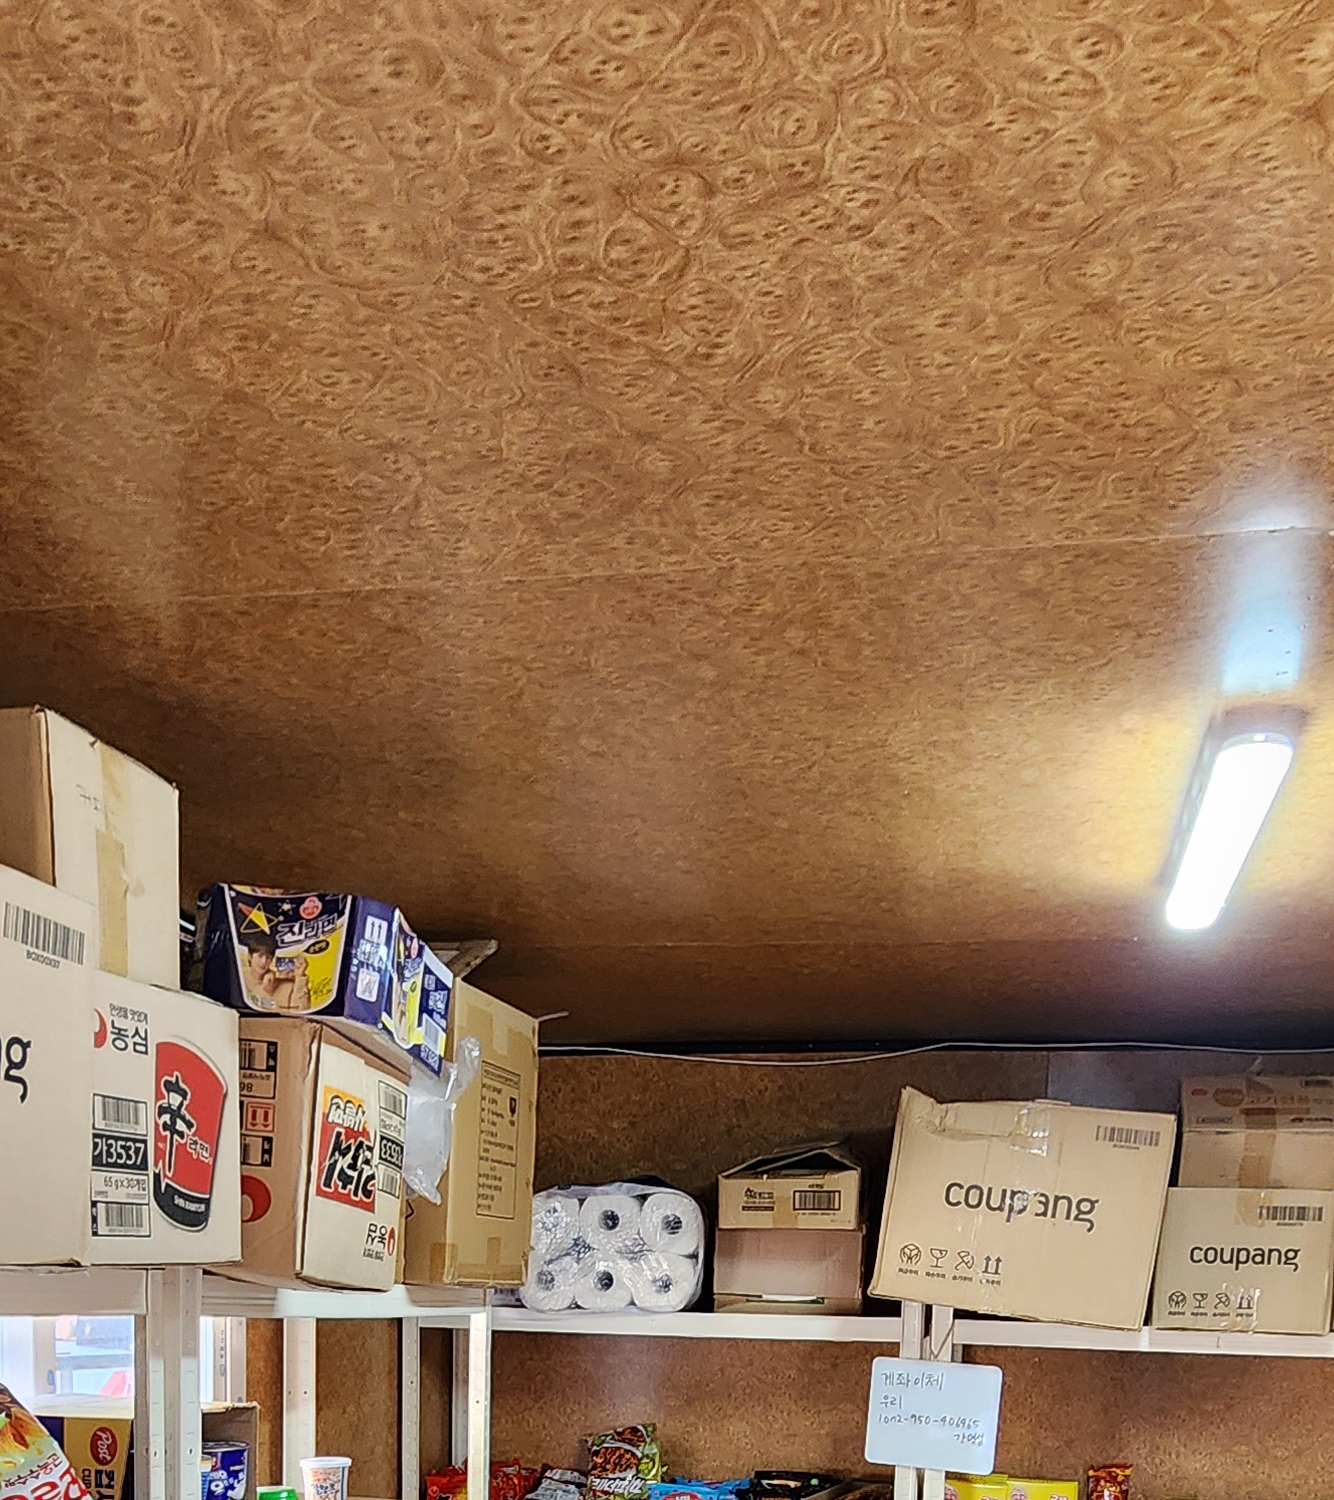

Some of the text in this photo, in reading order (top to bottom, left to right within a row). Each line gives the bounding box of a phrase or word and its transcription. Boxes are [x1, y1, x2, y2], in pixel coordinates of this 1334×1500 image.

[110, 1019, 149, 1056] 농심
[94, 1137, 145, 1166] 가3537
[187, 1136, 210, 1160] 라면
[944, 1180, 1100, 1234] coupang
[365, 1223, 388, 1251] 농심
[1189, 1243, 1301, 1273] coupang
[880, 1395, 903, 1410] 우리
[96, 1430, 113, 1463] Post
